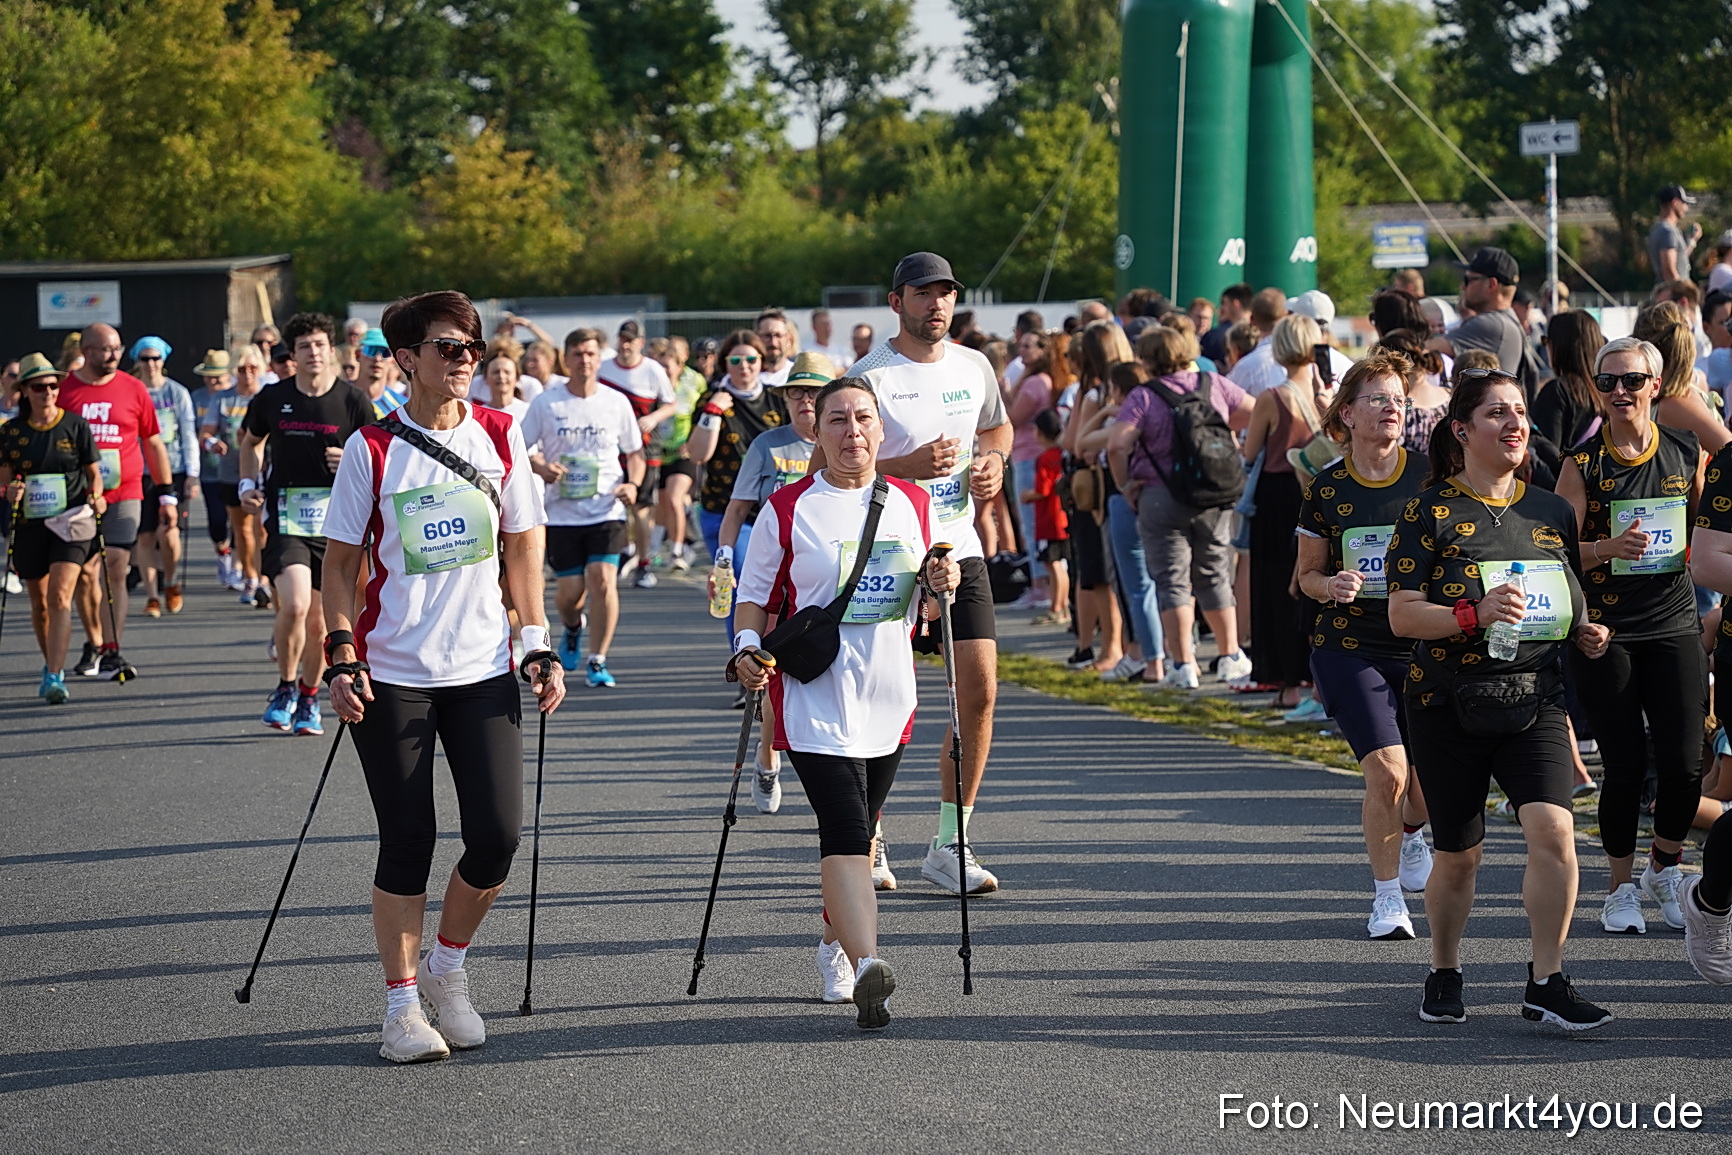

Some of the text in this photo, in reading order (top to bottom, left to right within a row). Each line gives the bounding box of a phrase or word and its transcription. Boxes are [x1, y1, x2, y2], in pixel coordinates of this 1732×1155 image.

[1525, 131, 1548, 147] WC
[891, 392, 919, 401] Kempa
[279, 420, 340, 434] Guttenberger
[929, 480, 960, 498] 1529
[299, 507, 323, 518] 1122
[423, 517, 466, 541] 609
[420, 537, 478, 554] Manuela Meyer
[1654, 548, 1674, 556] Baske
[1358, 557, 1386, 573] 20
[856, 575, 895, 592] 532
[850, 595, 901, 605] Olga Burghardt
[1526, 593, 1551, 610] 24
[1532, 614, 1557, 623] Nabati
